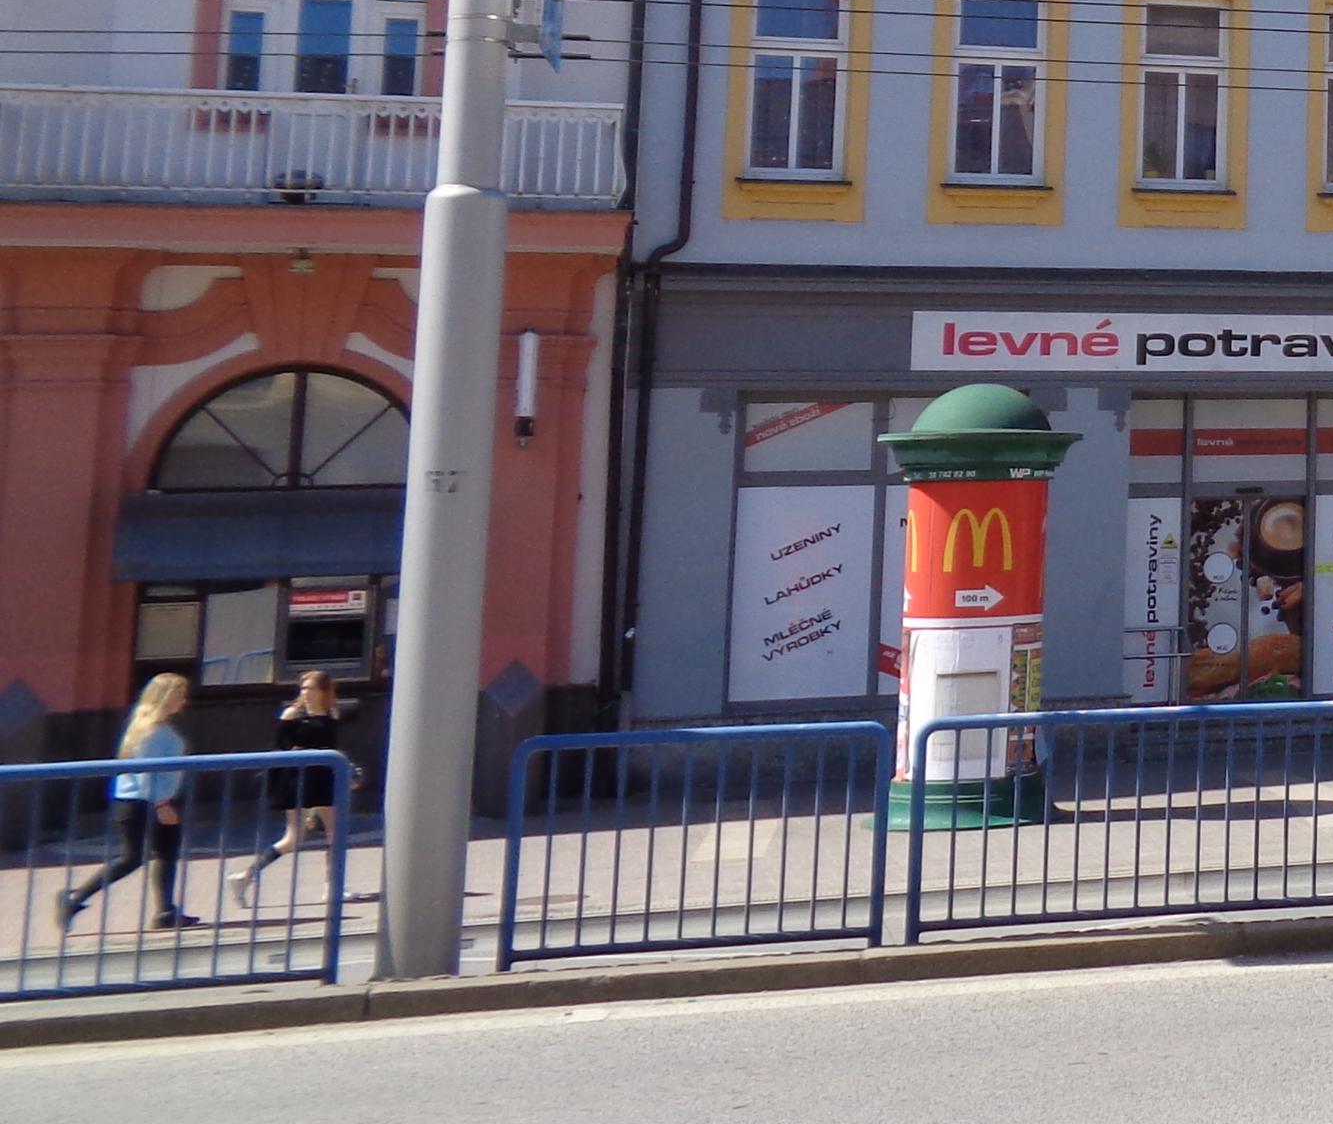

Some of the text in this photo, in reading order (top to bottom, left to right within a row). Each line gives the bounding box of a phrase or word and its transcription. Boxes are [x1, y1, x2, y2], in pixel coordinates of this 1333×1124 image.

[943, 319, 1119, 356] levné
[770, 523, 841, 561] UZENINY
[764, 564, 843, 605] LAHŮDKY
[961, 595, 978, 604] 100
[1142, 514, 1162, 689] levné potraviny
[762, 620, 841, 661] VÝROBKY
[763, 608, 833, 646] MLÉČNÉ
